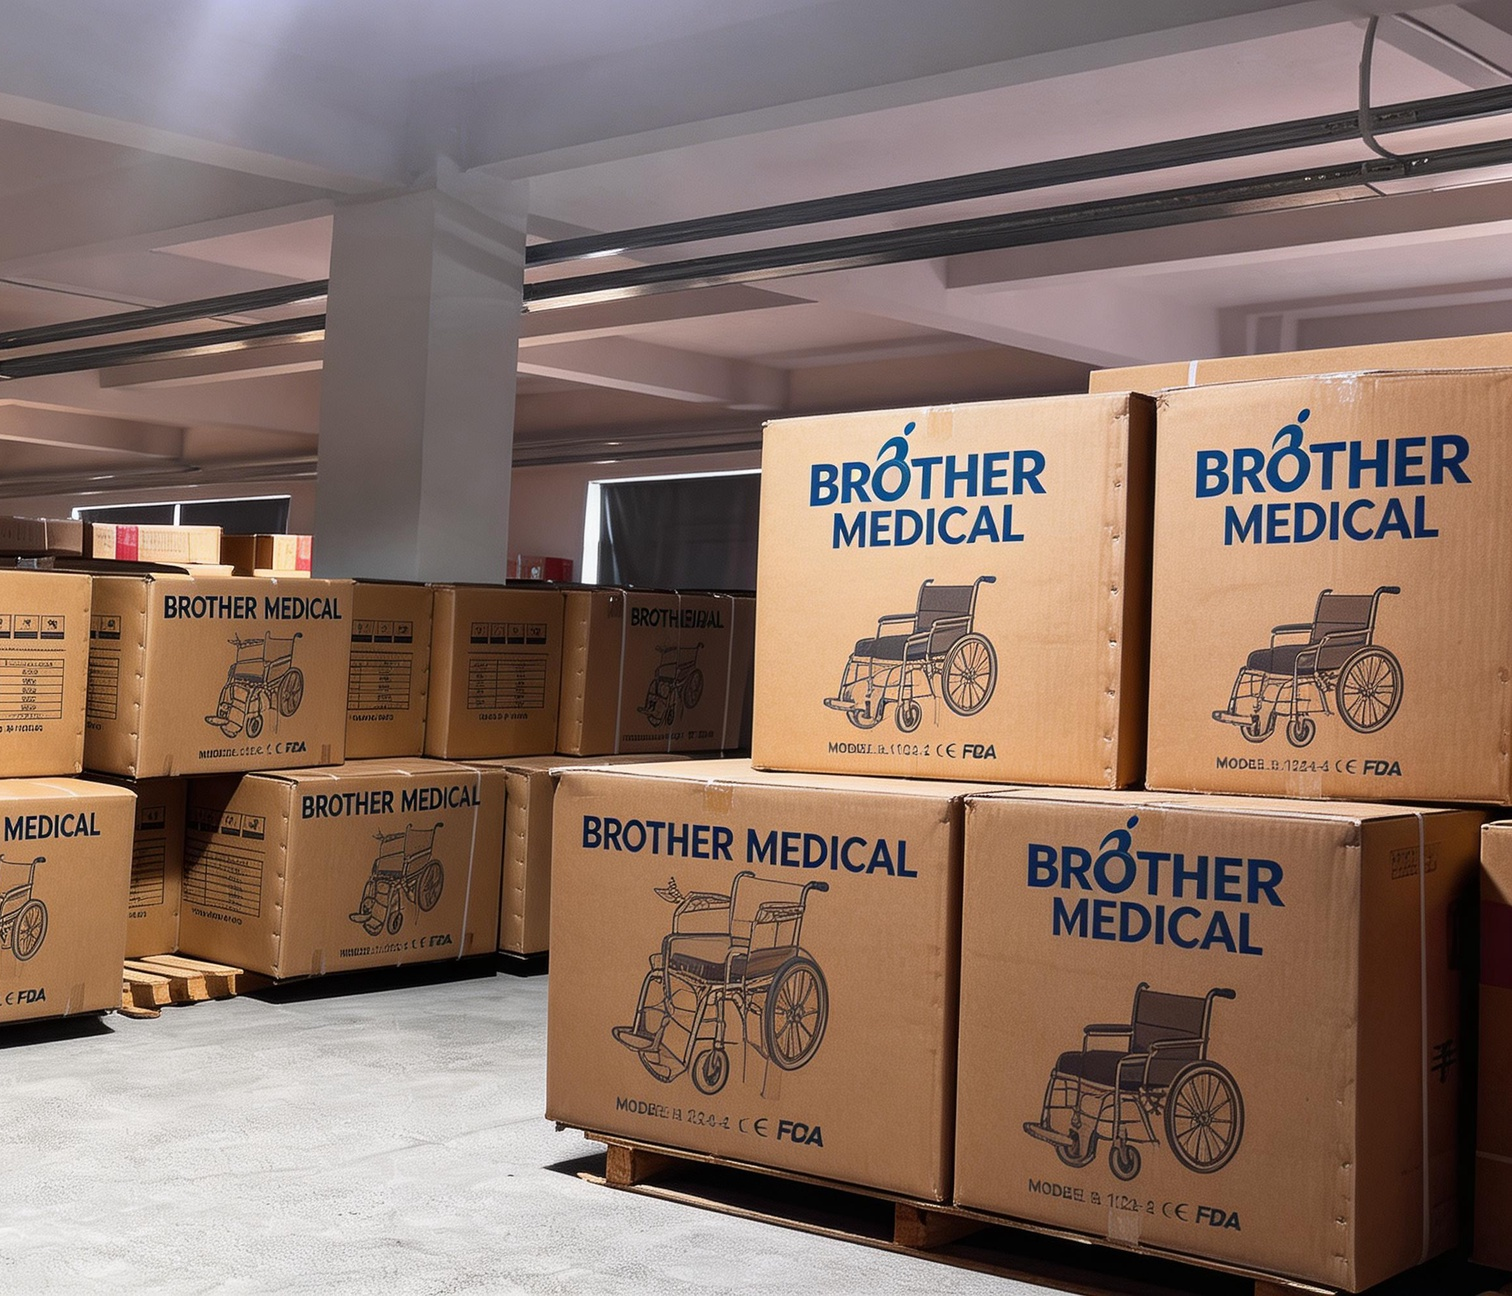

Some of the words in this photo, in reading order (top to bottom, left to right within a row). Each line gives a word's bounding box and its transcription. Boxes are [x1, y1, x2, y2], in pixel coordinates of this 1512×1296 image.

[809, 449, 1047, 506] BROTHER
[1195, 434, 1472, 498] BROTHER
[832, 504, 1025, 549] MEDICAL
[1224, 495, 1439, 546] MEDICAL
[163, 595, 257, 620] BROTHER
[263, 596, 342, 621] MEDICAL
[1362, 759, 1403, 777] FDA
[302, 792, 394, 819] BROTHER
[401, 784, 481, 813] MEDICAL
[3, 812, 101, 842] MEDICAL
[582, 815, 734, 860] BROTHER
[746, 828, 918, 878] MEDICAL
[1026, 842, 1286, 907] BROTHER
[1051, 896, 1264, 956] MEDICAL
[17, 987, 47, 1005] FDA
[1195, 1205, 1242, 1231] FDA
